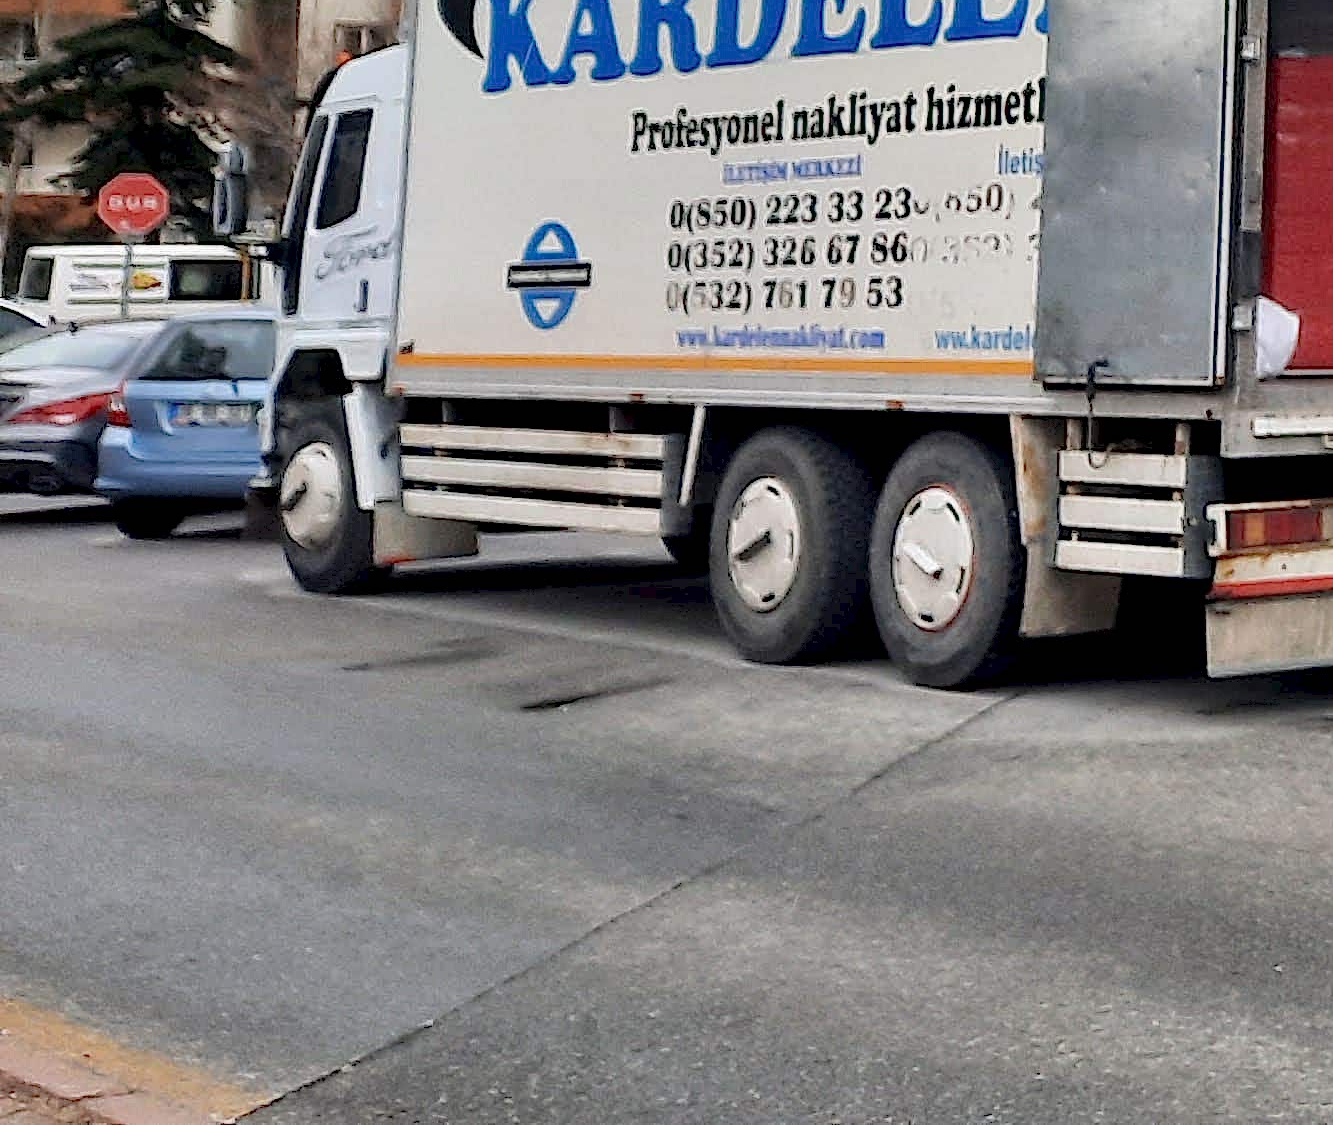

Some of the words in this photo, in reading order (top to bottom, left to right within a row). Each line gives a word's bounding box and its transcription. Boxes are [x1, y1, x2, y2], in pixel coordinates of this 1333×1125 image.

[631, 99, 785, 155] Profesyonel
[792, 89, 917, 144] nakliyat
[670, 198, 757, 234] 0(850)
[766, 192, 818, 225] 223
[827, 189, 864, 222] 33
[875, 186, 912, 220] 23
[667, 237, 754, 275] 0(352)
[763, 233, 816, 268] 326
[827, 232, 860, 265] 67
[870, 230, 909, 265] 86
[763, 280, 808, 308] 761
[821, 278, 856, 309] 79
[866, 275, 903, 308] 53
